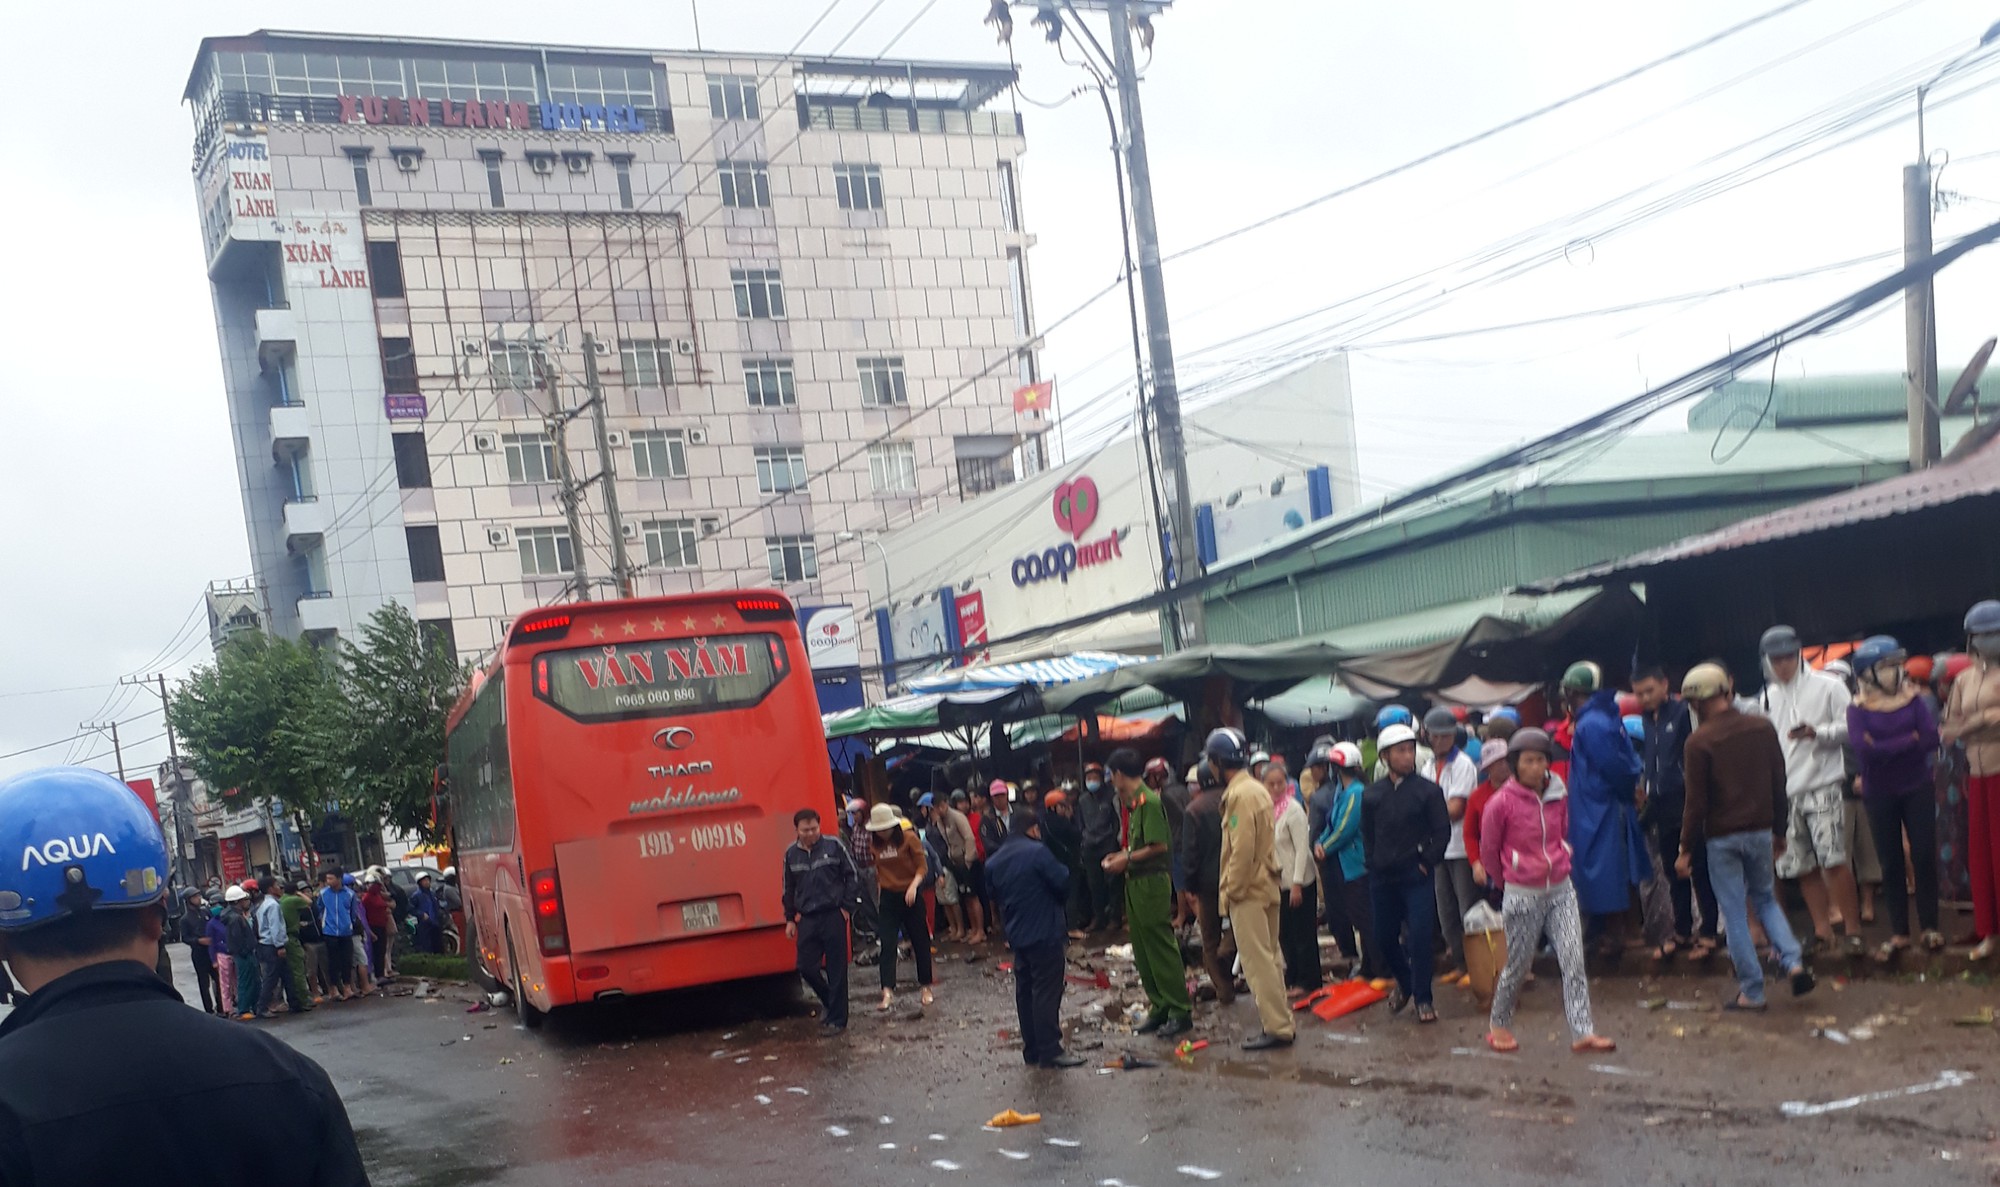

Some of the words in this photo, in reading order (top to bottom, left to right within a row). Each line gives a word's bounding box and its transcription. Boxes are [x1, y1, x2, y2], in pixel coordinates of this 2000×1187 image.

[539, 100, 645, 132] HOTEL
[226, 142, 268, 161] HOTEL
[319, 266, 367, 288] LÀNH
[575, 645, 655, 689] VĂN
[664, 637, 751, 681] NĂM
[648, 761, 713, 778] THACO
[22, 833, 116, 871] AQUA
[637, 831, 674, 858] 19B
[691, 822, 746, 852] 00918
